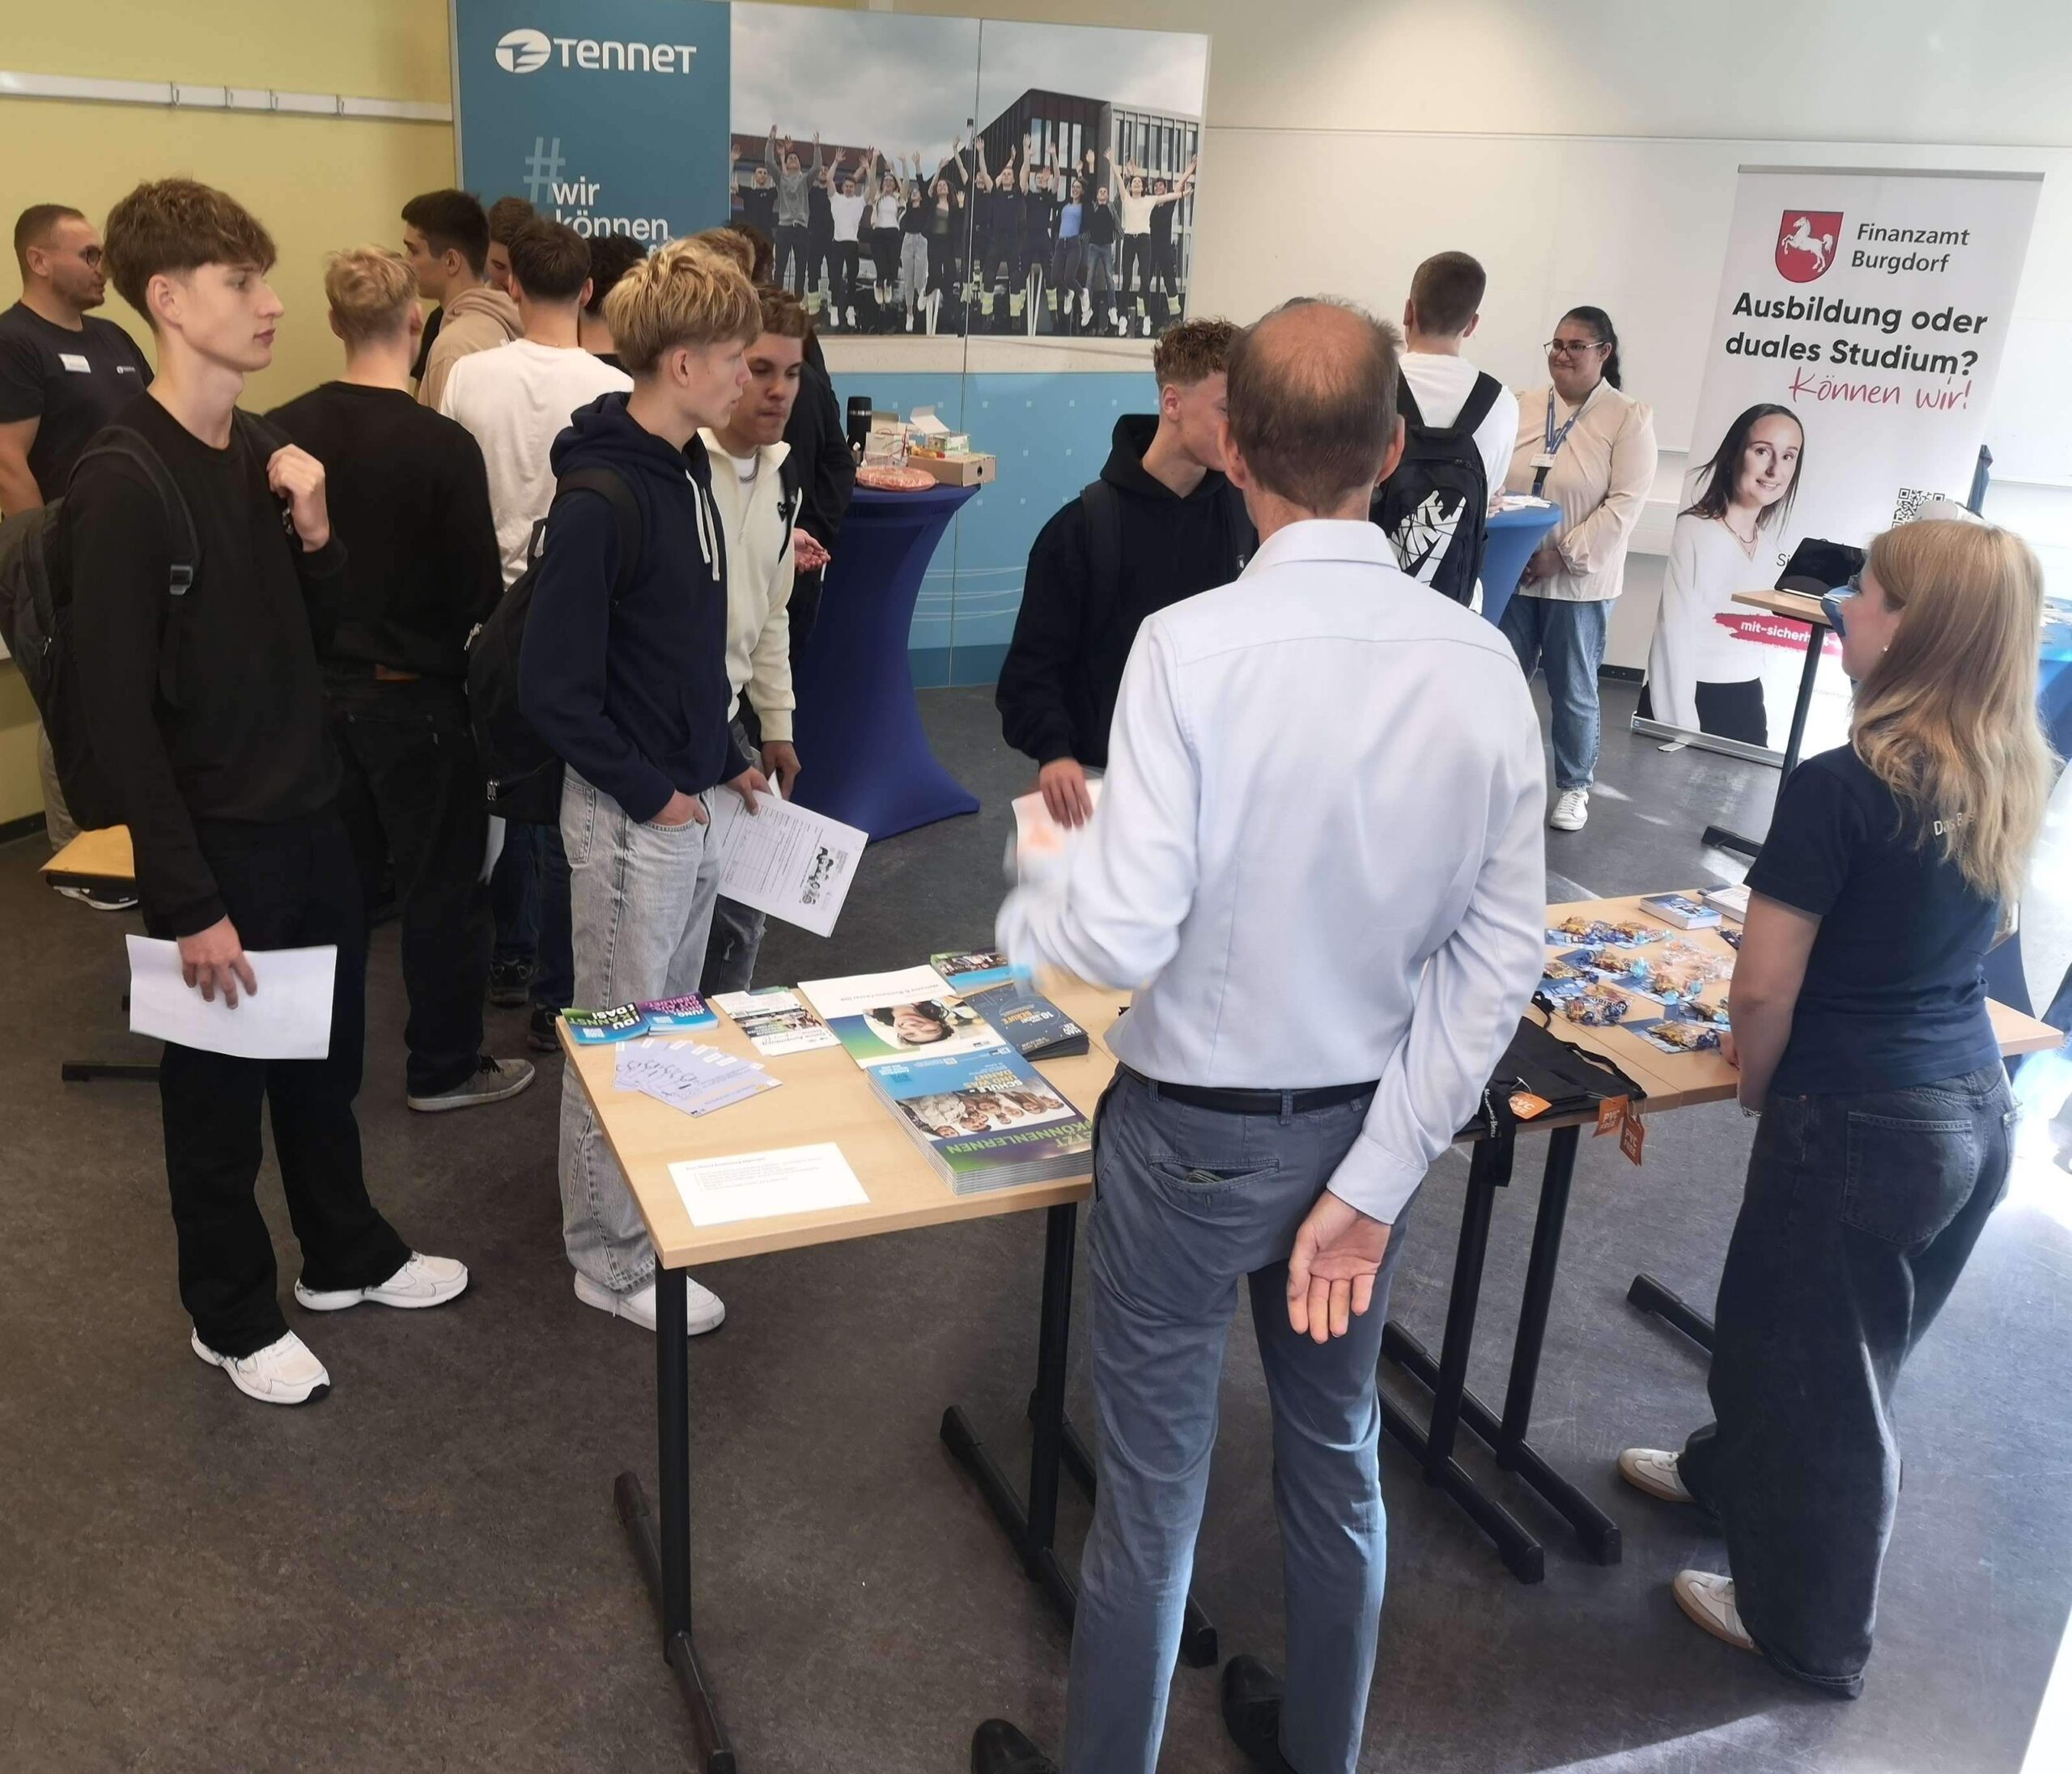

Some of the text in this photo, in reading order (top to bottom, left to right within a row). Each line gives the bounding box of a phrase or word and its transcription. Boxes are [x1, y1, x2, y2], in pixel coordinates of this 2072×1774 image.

[1857, 223, 1970, 246] Finanzamt
[1851, 250, 1951, 274] Burgdorf
[1732, 291, 1988, 334] Ausbildung oder
[1725, 332, 1979, 376] duales Studium?
[1788, 367, 1972, 410] Können wir!
[569, 1012, 631, 1026] KANNST
[613, 1017, 635, 1030] DU
[977, 1078, 1023, 1093] SCHULE
[1509, 1095, 1535, 1111] PVC
[1603, 1110, 1620, 1122] PVC
[1057, 1131, 1092, 1148] ETZT
[1625, 1130, 1639, 1148] PVC
[1624, 1140, 1637, 1156] FREE
